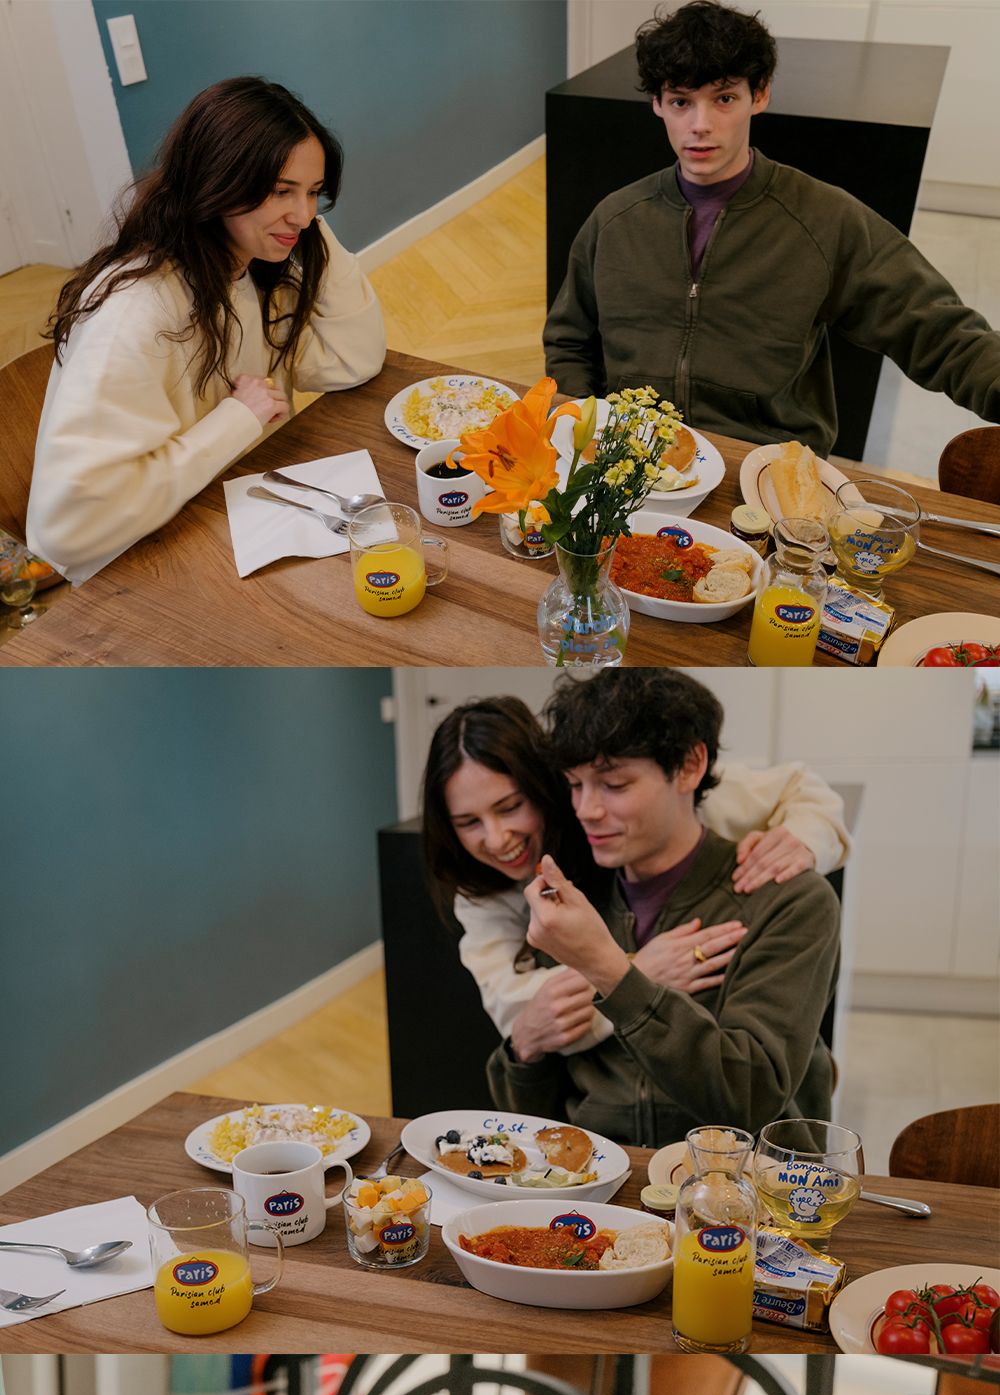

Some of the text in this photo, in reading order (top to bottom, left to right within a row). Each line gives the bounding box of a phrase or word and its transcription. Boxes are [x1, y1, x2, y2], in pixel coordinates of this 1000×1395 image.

[847, 535, 873, 550] MON
[483, 1118, 529, 1133] C'est
[778, 1172, 839, 1187] MON Ami
[294, 1215, 309, 1227] club
[692, 1251, 729, 1267] Parisian
[170, 1283, 225, 1300] Parisian club
[760, 1296, 796, 1315] Beurre
